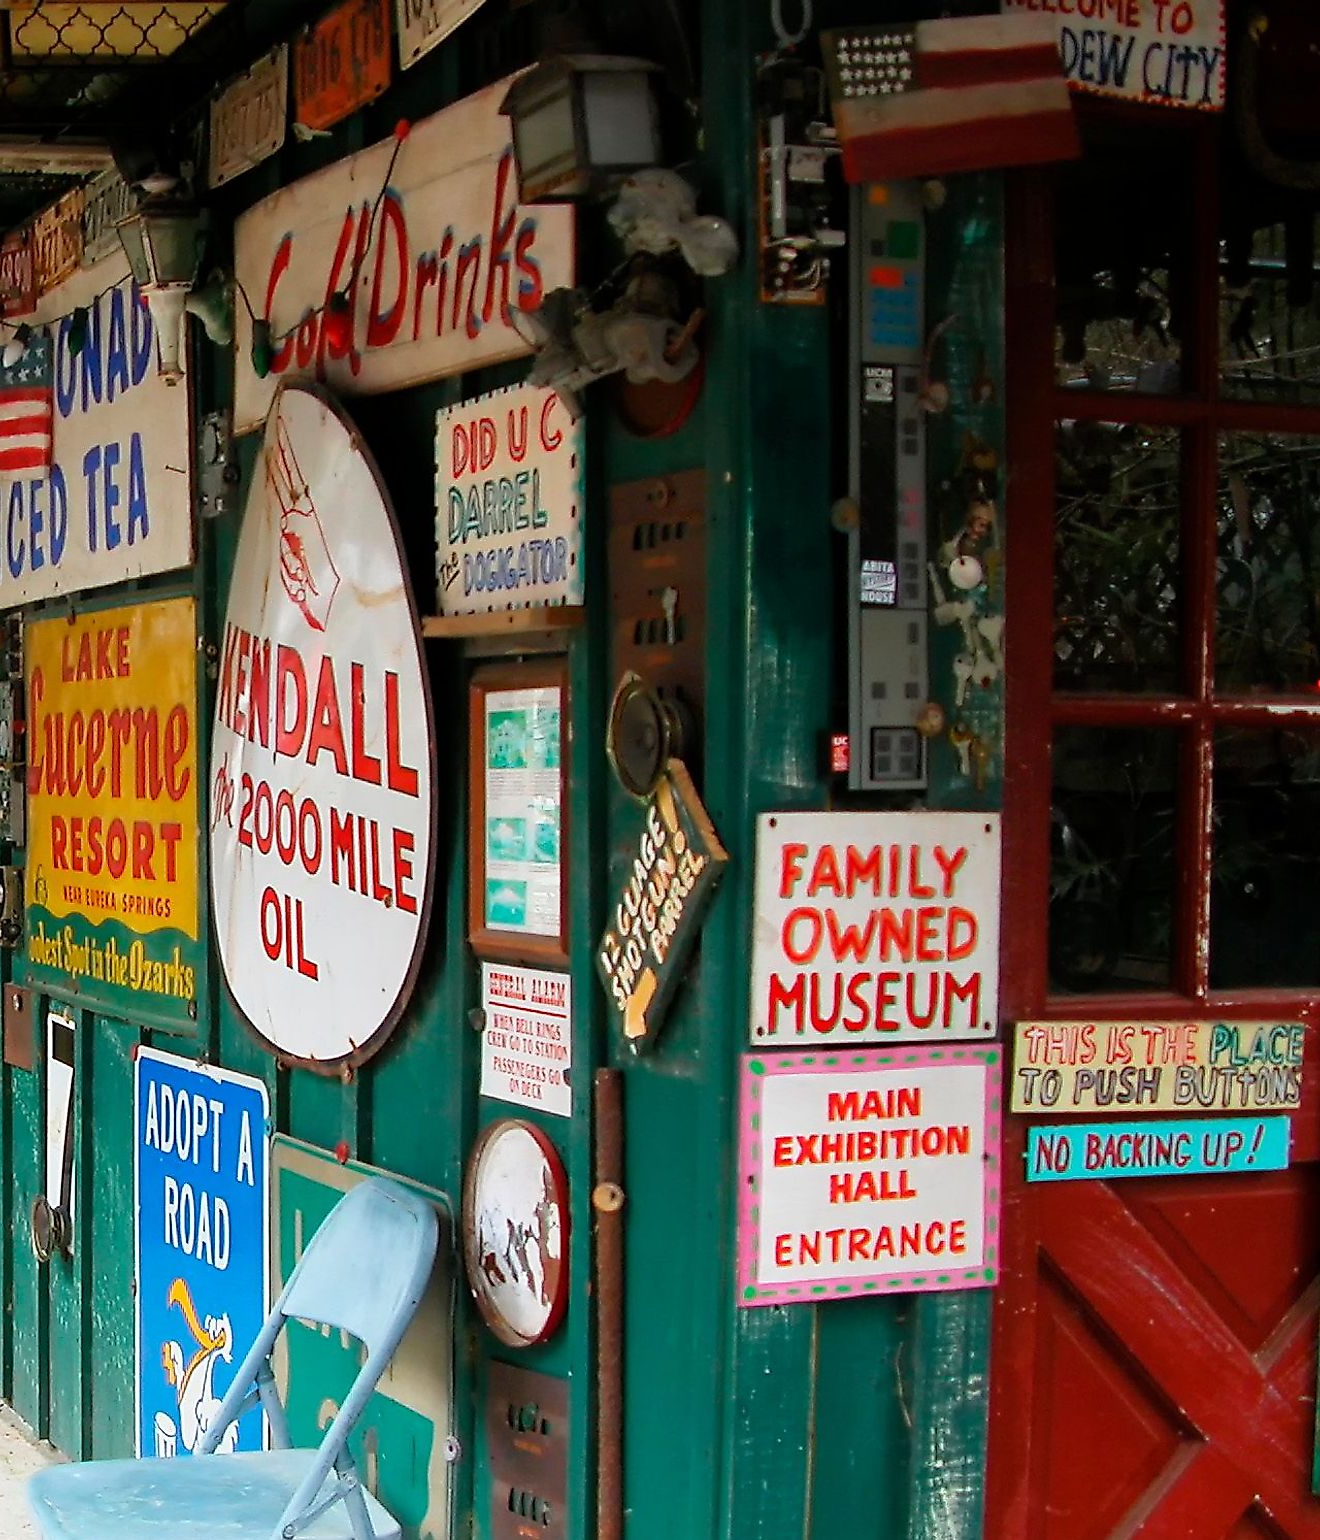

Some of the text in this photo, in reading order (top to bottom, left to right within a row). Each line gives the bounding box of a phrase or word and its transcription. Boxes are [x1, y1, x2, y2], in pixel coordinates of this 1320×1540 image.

[1153, 0, 1193, 34] TO
[1142, 41, 1220, 104] CITY
[367, 146, 544, 347] Drinks
[452, 392, 563, 479] DID U C
[83, 431, 151, 553] TEA
[448, 467, 549, 545] DARREL
[463, 536, 569, 597] DOGIGATOR
[61, 626, 130, 683] LAKE
[27, 666, 191, 802] Lucerne
[218, 621, 420, 798] KENDALL
[51, 815, 183, 883] RESORT
[238, 772, 323, 876] 2000
[330, 806, 418, 916] MILE
[779, 842, 968, 899] FAMILY
[86, 888, 117, 912] EUREKA
[122, 893, 171, 918] SPRINGS
[260, 885, 319, 982] OIL
[781, 906, 979, 966] OWNED
[104, 936, 127, 987] the
[129, 940, 194, 1000] Ozarks
[493, 1013, 562, 1042] WHEN BELL RINGS
[767, 971, 981, 1035] MUSEUM
[487, 1030, 569, 1061] CREW GO TO STATION
[1025, 1022, 1304, 1067] THIS IS THE PLACE
[508, 1078, 543, 1100] ON DECK
[548, 1068, 561, 1086] GO
[827, 1087, 923, 1122] MAIN
[1018, 1064, 1301, 1108] TO PUSH BUTTONS
[144, 1080, 256, 1187] ADOPT A
[773, 1125, 970, 1168] EXHIBITION
[1035, 1133, 1072, 1174] NO
[1084, 1132, 1192, 1171] BACKING
[829, 1169, 918, 1204] HALL
[164, 1175, 230, 1271] ROAD
[774, 1220, 967, 1268] ENTRANCE
